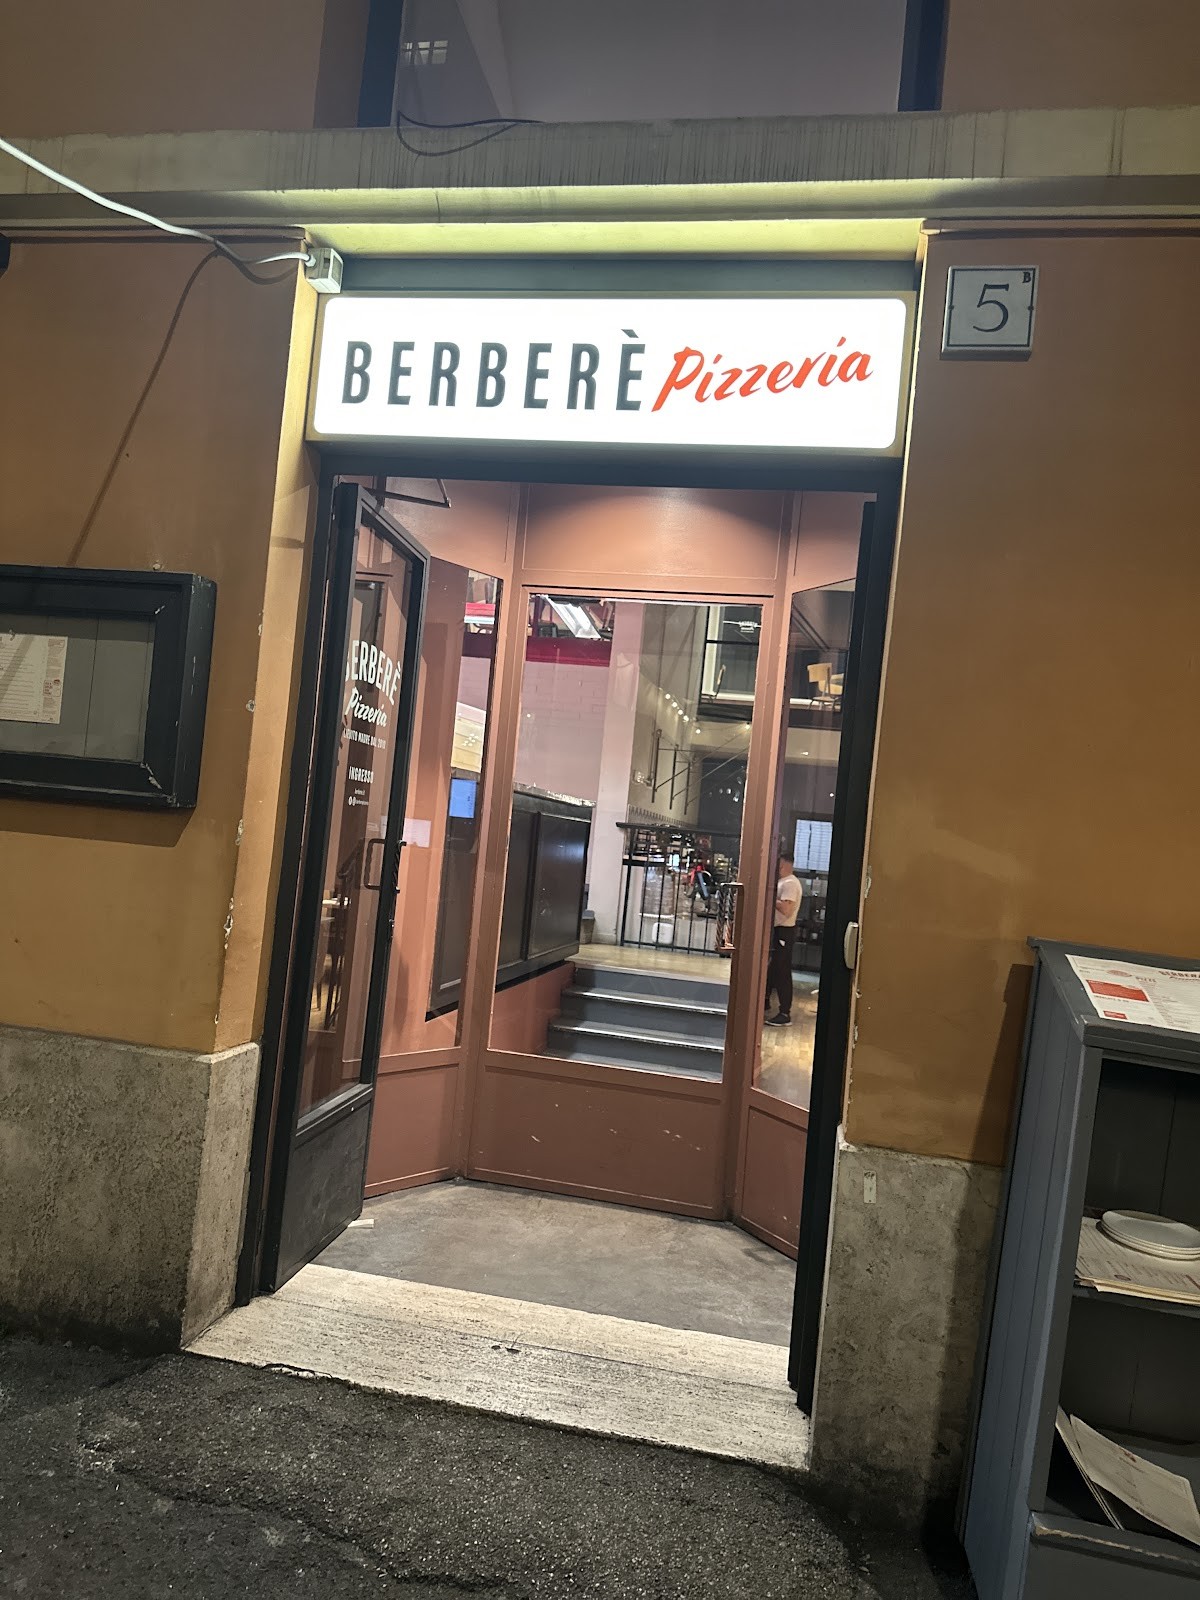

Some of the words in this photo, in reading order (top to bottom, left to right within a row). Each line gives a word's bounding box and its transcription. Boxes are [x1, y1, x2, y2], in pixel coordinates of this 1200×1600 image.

[972, 283, 1010, 333] 5
[1022, 271, 1032, 284] B
[341, 328, 646, 413] BERBERÈ
[651, 336, 874, 413] Pizzeria
[344, 686, 388, 728] Pizzeria
[348, 766, 374, 784] INGRESSO
